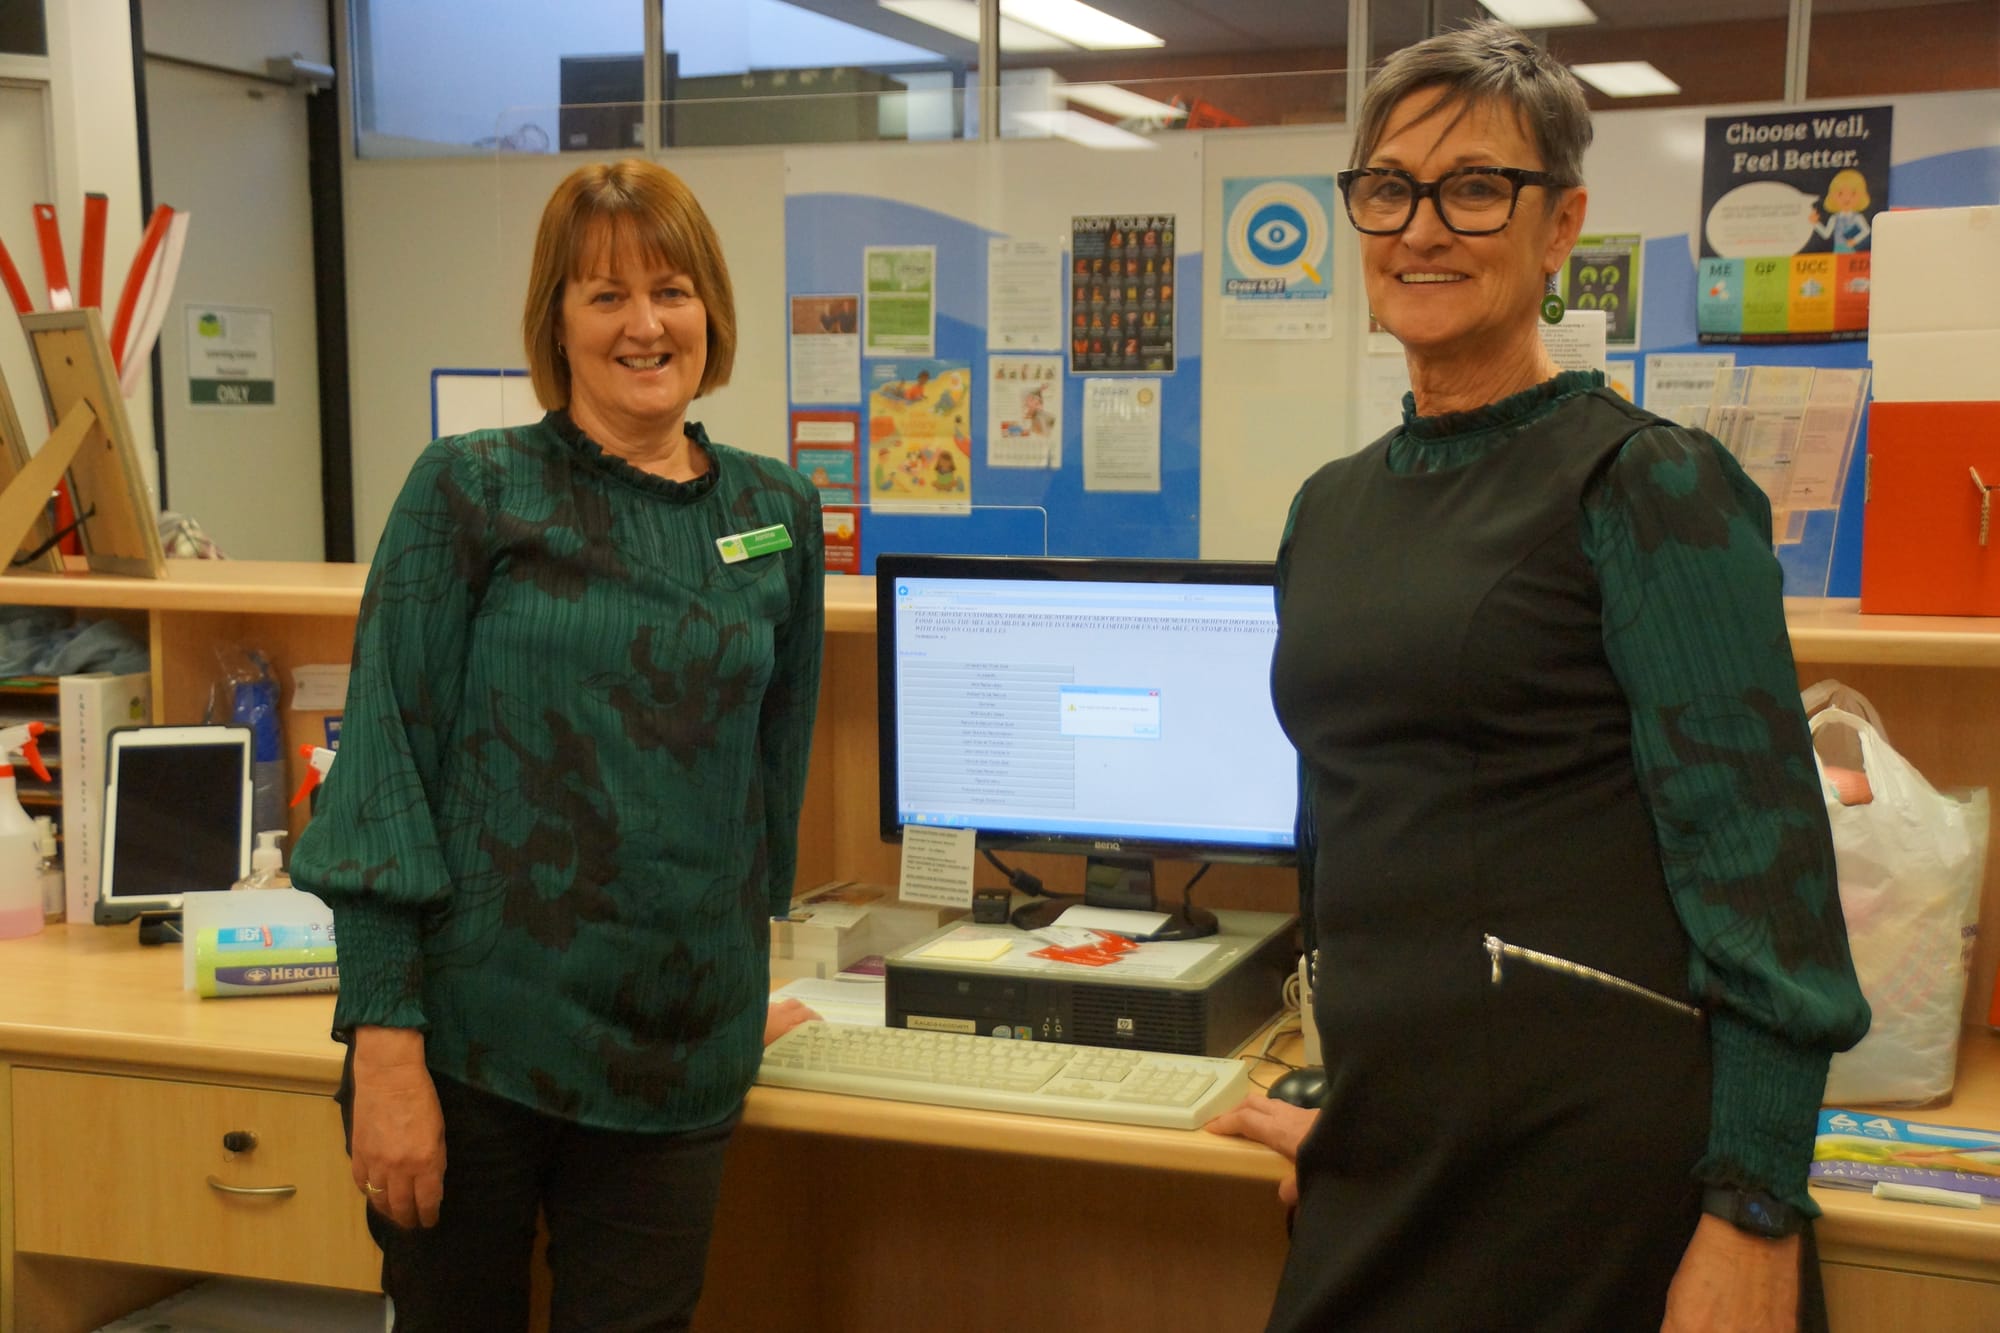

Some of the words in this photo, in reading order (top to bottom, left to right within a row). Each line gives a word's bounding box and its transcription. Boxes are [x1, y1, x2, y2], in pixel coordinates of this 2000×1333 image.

[1726, 120, 1808, 145] Choose
[1812, 115, 1870, 140] Well,
[1732, 150, 1778, 173] Feel
[1783, 148, 1860, 171] Better.
[1073, 216, 1110, 232] KNOW
[1114, 216, 1149, 231] YOUR
[1150, 215, 1173, 230] A-Z
[1709, 263, 1732, 278] ME
[1094, 840, 1121, 851] BenQ
[270, 966, 339, 981] HERCUL
[1828, 1113, 1897, 1138] 64
[1820, 1160, 1940, 1177] EXERCISE
